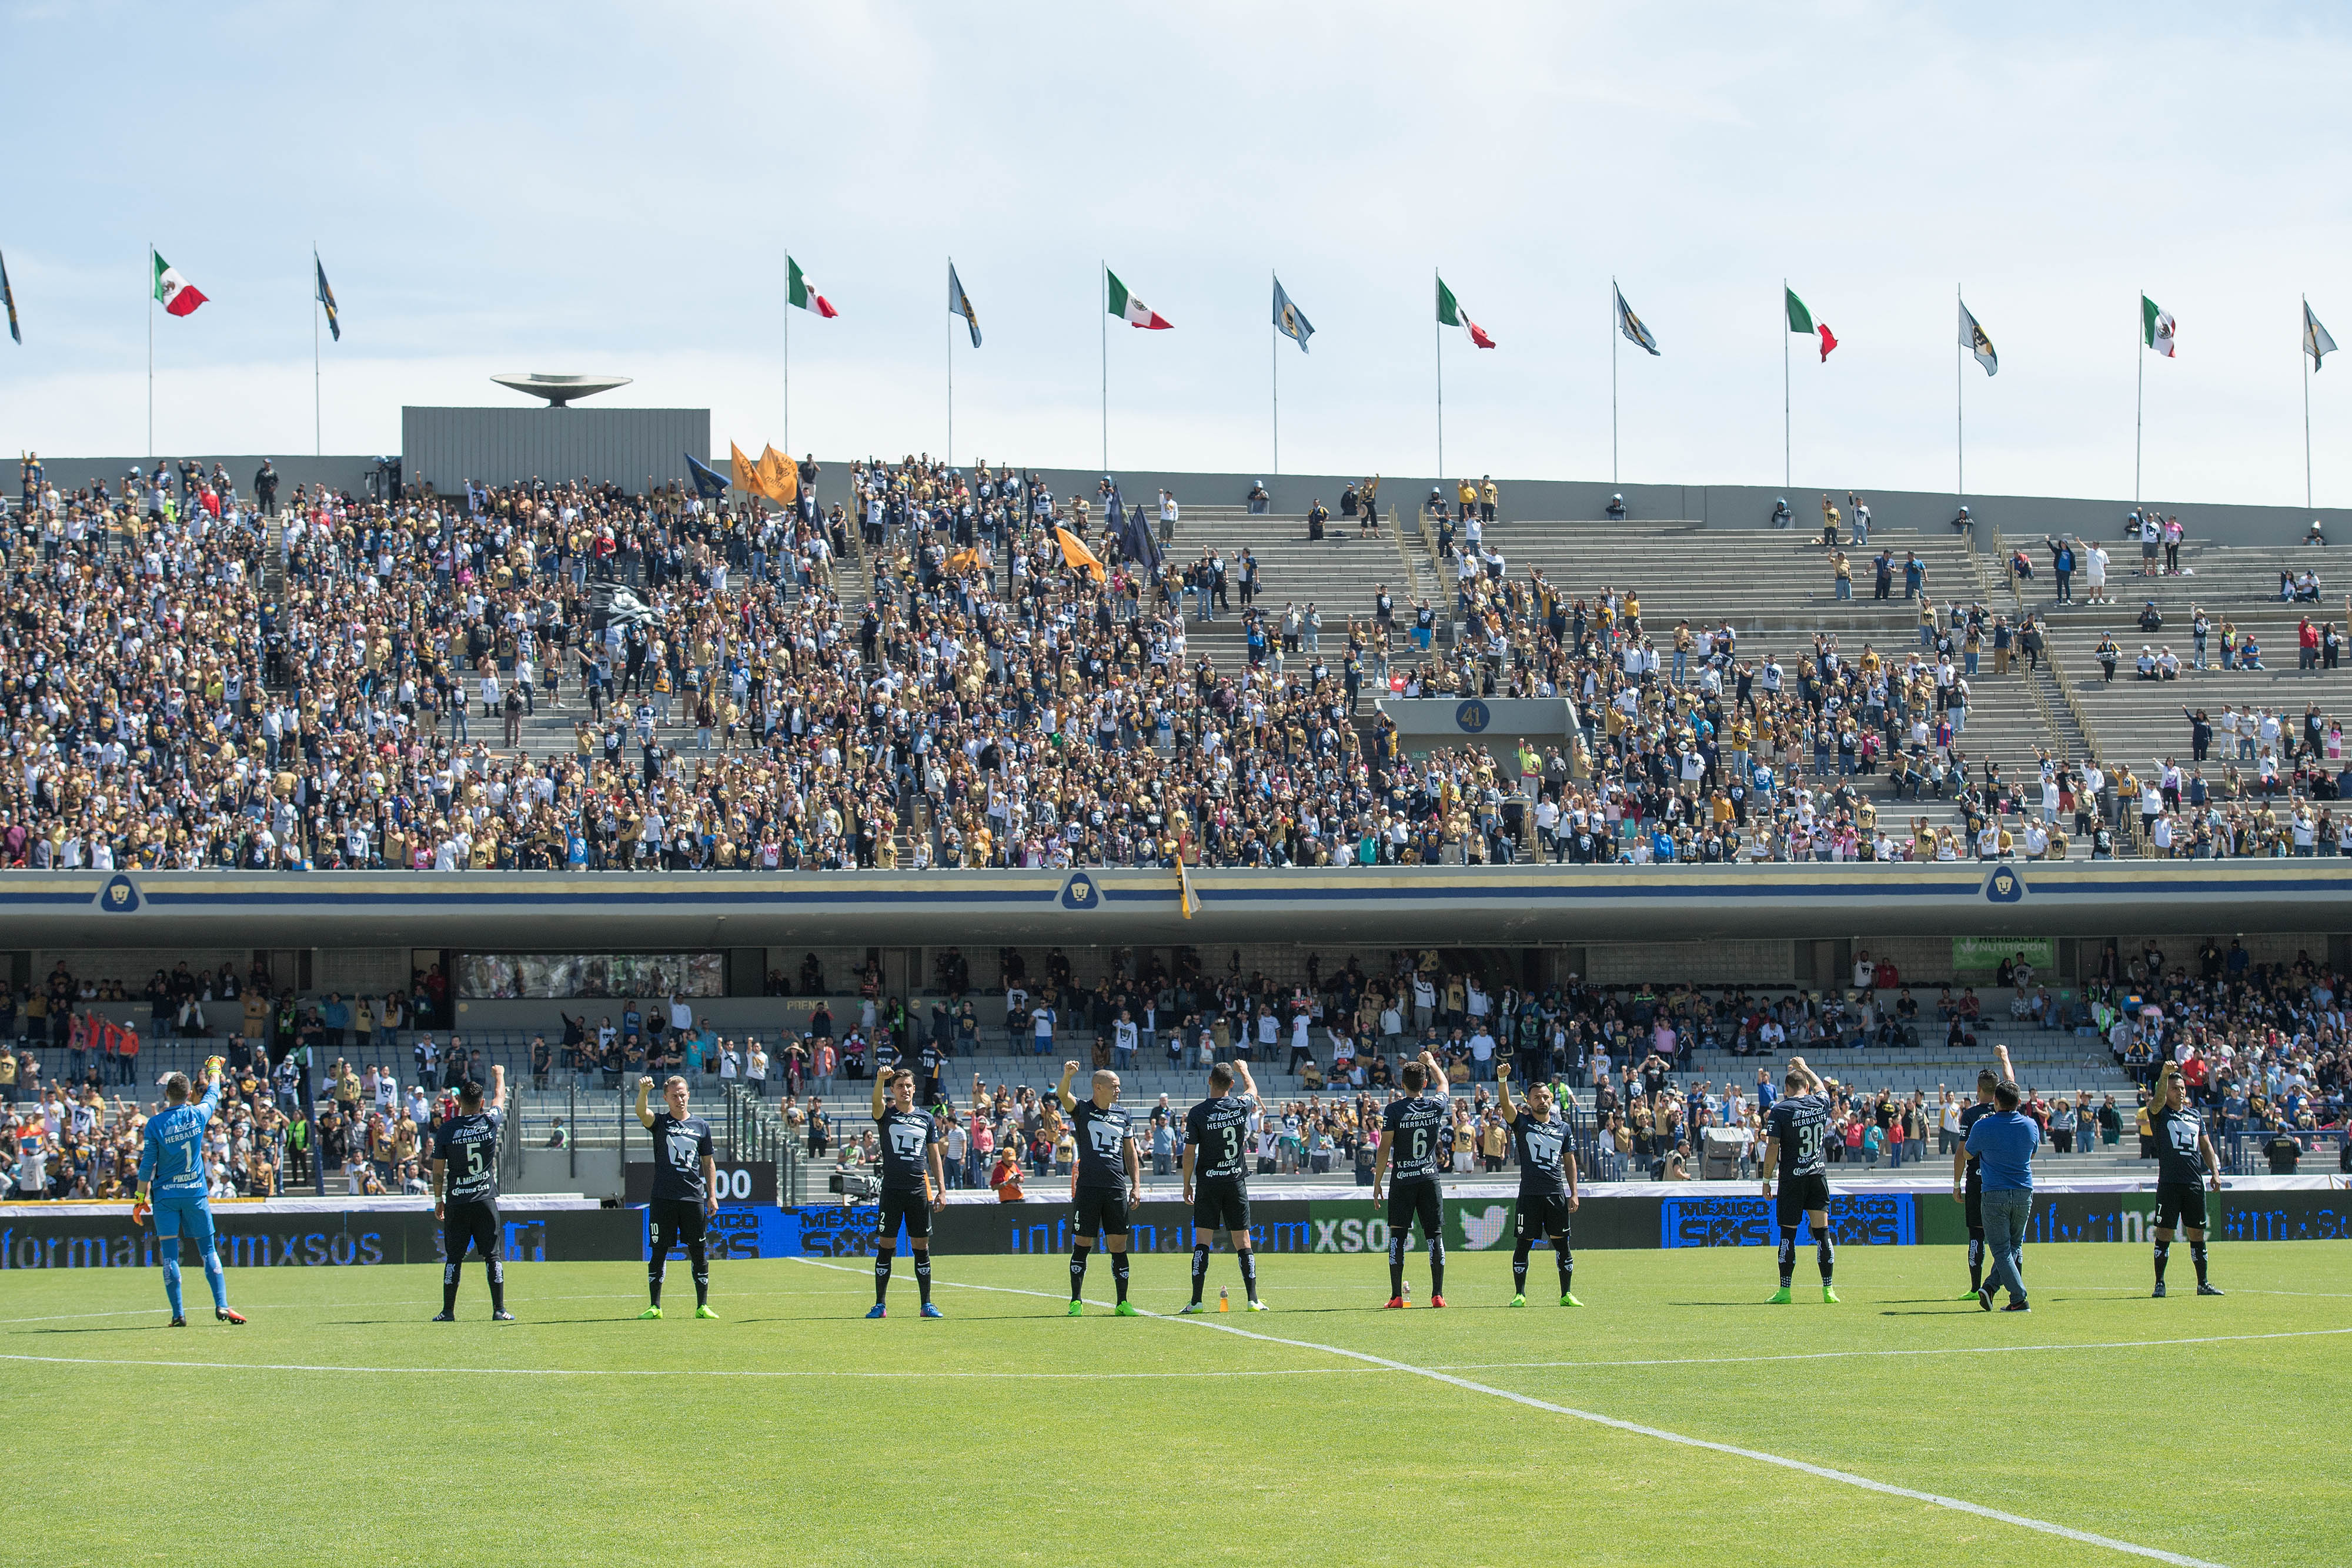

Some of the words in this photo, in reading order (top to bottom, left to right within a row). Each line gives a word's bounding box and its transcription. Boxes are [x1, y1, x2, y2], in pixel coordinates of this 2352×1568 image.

[1461, 707, 1481, 727] 41
[1419, 950, 1439, 971] 28
[787, 1001, 829, 1010] PRENA
[923, 1057, 935, 1068] 116
[1801, 1105, 1825, 1118] telcel
[891, 1115, 927, 1127] DHL
[1207, 1116, 1245, 1130] HERBALIFE
[1400, 1117, 1439, 1129] HERBALIFE
[1792, 1114, 1827, 1127] HERBALIFE
[165, 1126, 202, 1144] HERBALIFE
[667, 1126, 701, 1137] DHL
[452, 1132, 493, 1145] HERBALIFE
[1223, 1126, 1238, 1159] 3
[1413, 1128, 1428, 1159] 6
[1799, 1123, 1824, 1157] 30
[181, 1141, 192, 1172] 1
[467, 1142, 483, 1175] 5
[1397, 1169, 1420, 1179] Corona
[2158, 1203, 2162, 1215] 7
[880, 1212, 885, 1224] 2
[1075, 1211, 1080, 1222] 4
[1518, 1213, 1524, 1225] 11
[650, 1223, 659, 1235] 10
